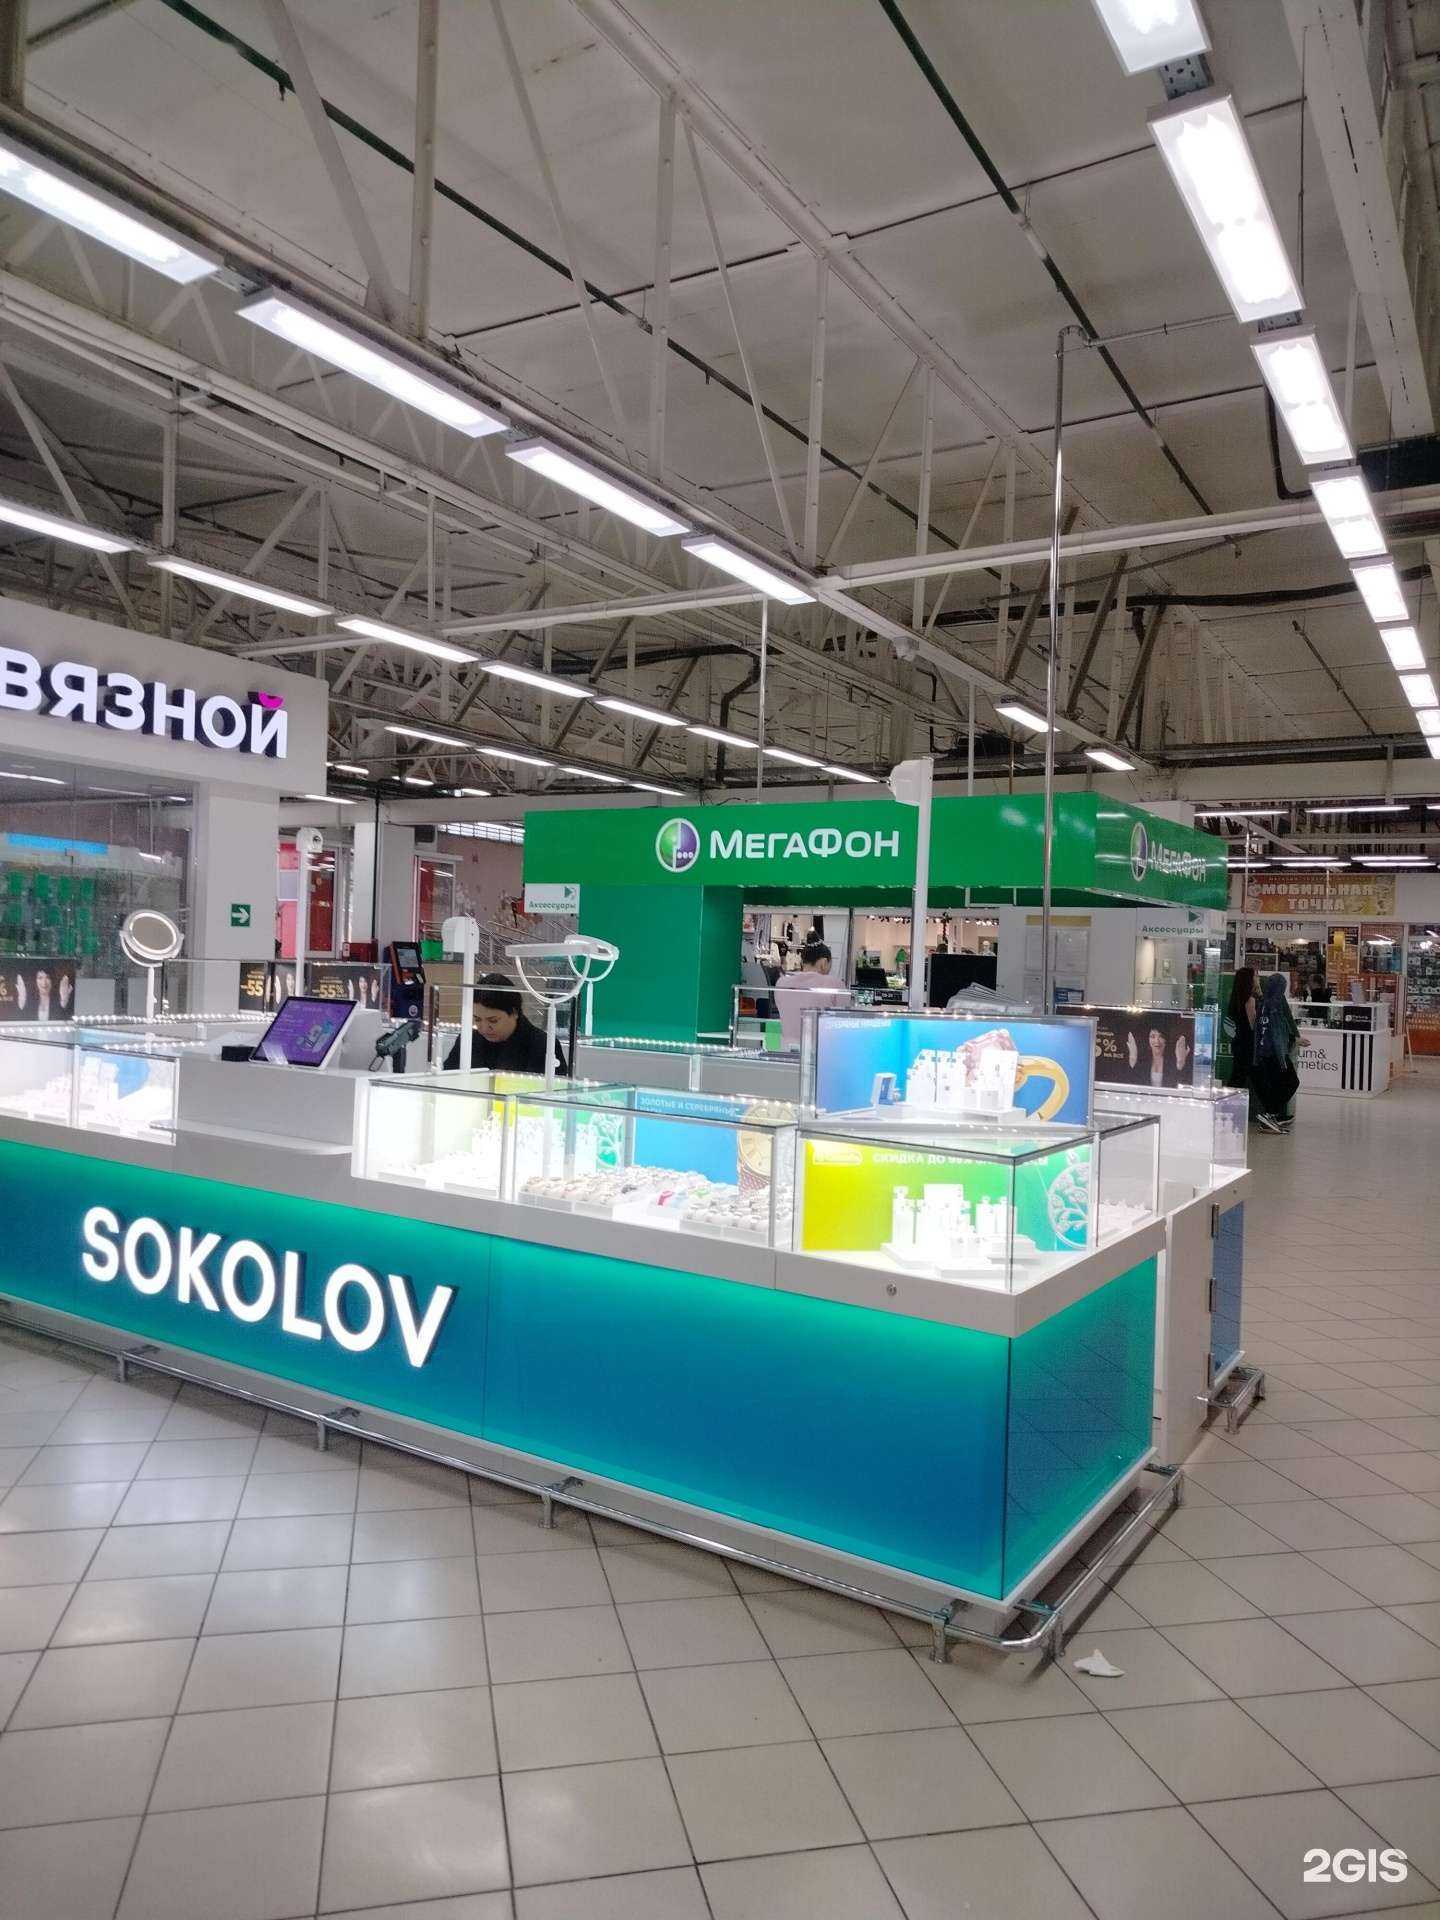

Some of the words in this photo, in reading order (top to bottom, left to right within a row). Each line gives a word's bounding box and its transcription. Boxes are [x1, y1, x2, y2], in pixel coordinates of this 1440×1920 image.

[1262, 883, 1375, 897] МОБИЛЬНАЯ
[1287, 898, 1345, 911] ТОЧКА
[1142, 924, 1205, 936] Аксессуары
[1245, 922, 1304, 932] РЕМОНТ
[82, 1206, 453, 1368] SOKOLOV
